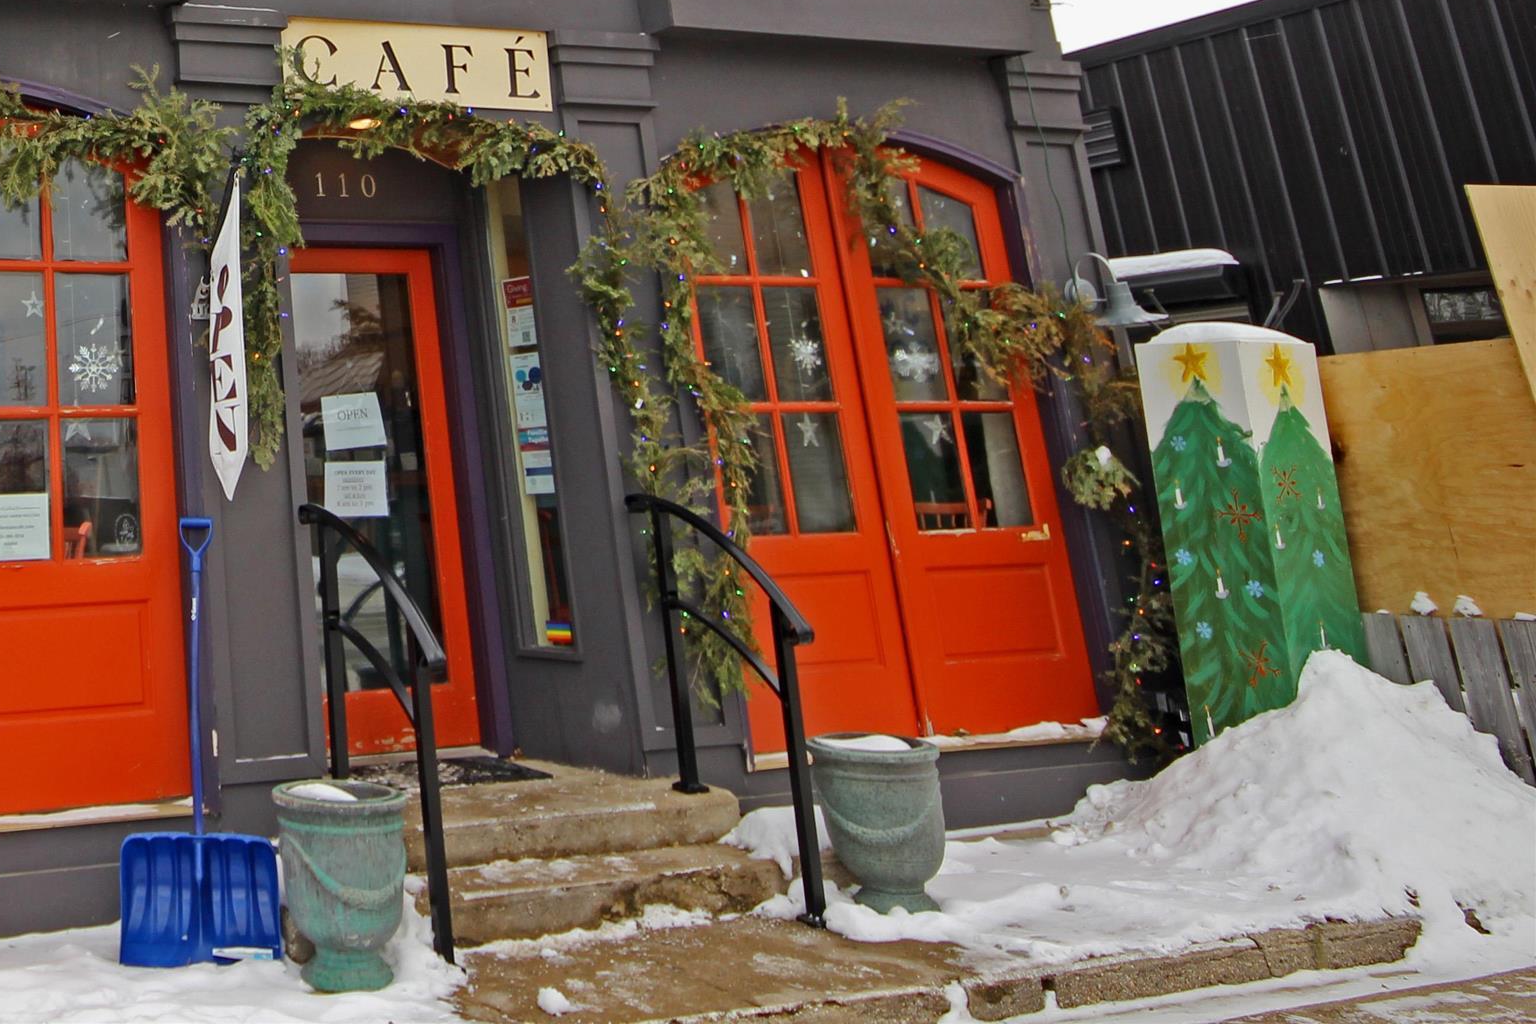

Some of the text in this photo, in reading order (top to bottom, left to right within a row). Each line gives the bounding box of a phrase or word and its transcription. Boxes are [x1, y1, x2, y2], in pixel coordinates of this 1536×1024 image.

[293, 34, 541, 98] CAFÉ
[315, 172, 376, 198] 110
[337, 408, 368, 421] OPEN
